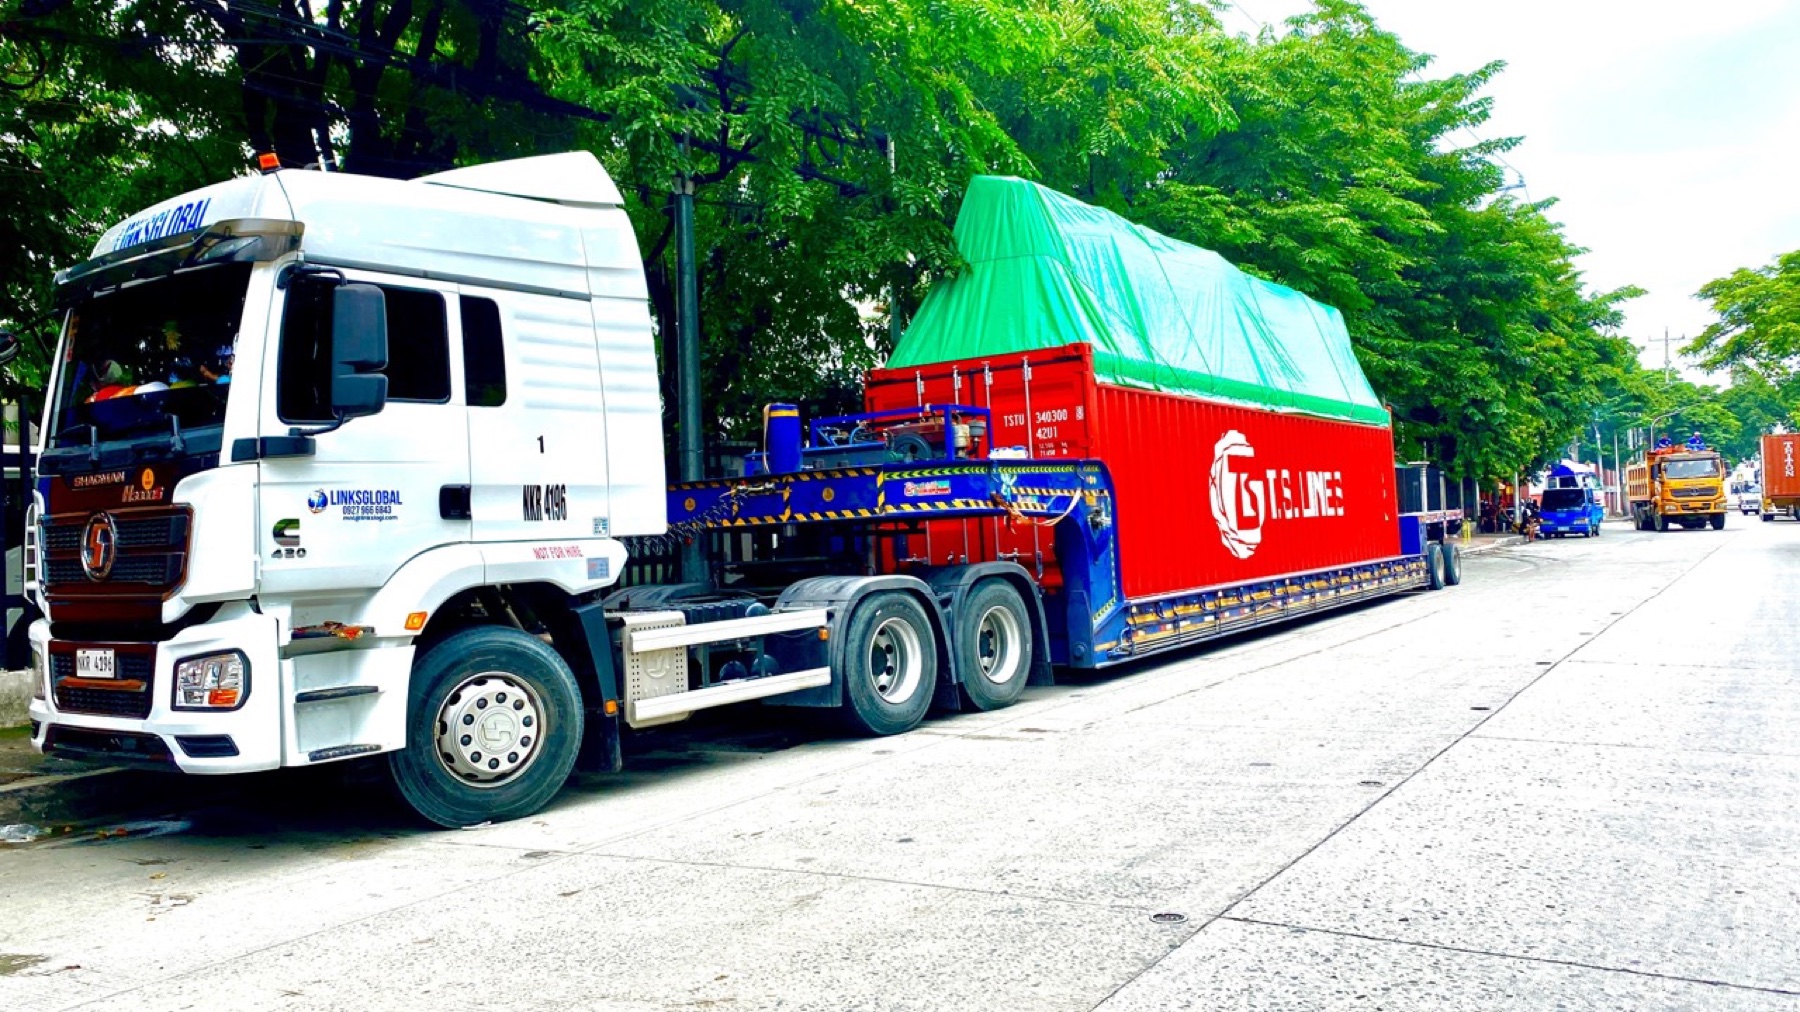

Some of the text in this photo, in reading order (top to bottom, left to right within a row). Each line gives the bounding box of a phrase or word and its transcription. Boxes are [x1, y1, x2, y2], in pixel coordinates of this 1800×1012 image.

[1003, 413, 1025, 428] TSTU
[1035, 408, 1068, 424] 340300
[1036, 425, 1058, 440] 42U1
[536, 434, 545, 454] 1
[1783, 441, 1795, 477] TRITON
[330, 489, 403, 506] LINKSGLOBAL
[522, 483, 568, 521] NKR 4196
[342, 505, 360, 515] 0927
[271, 547, 307, 558] 420
[532, 545, 584, 560] NOT FOR HIRE
[93, 655, 112, 671] 4196
